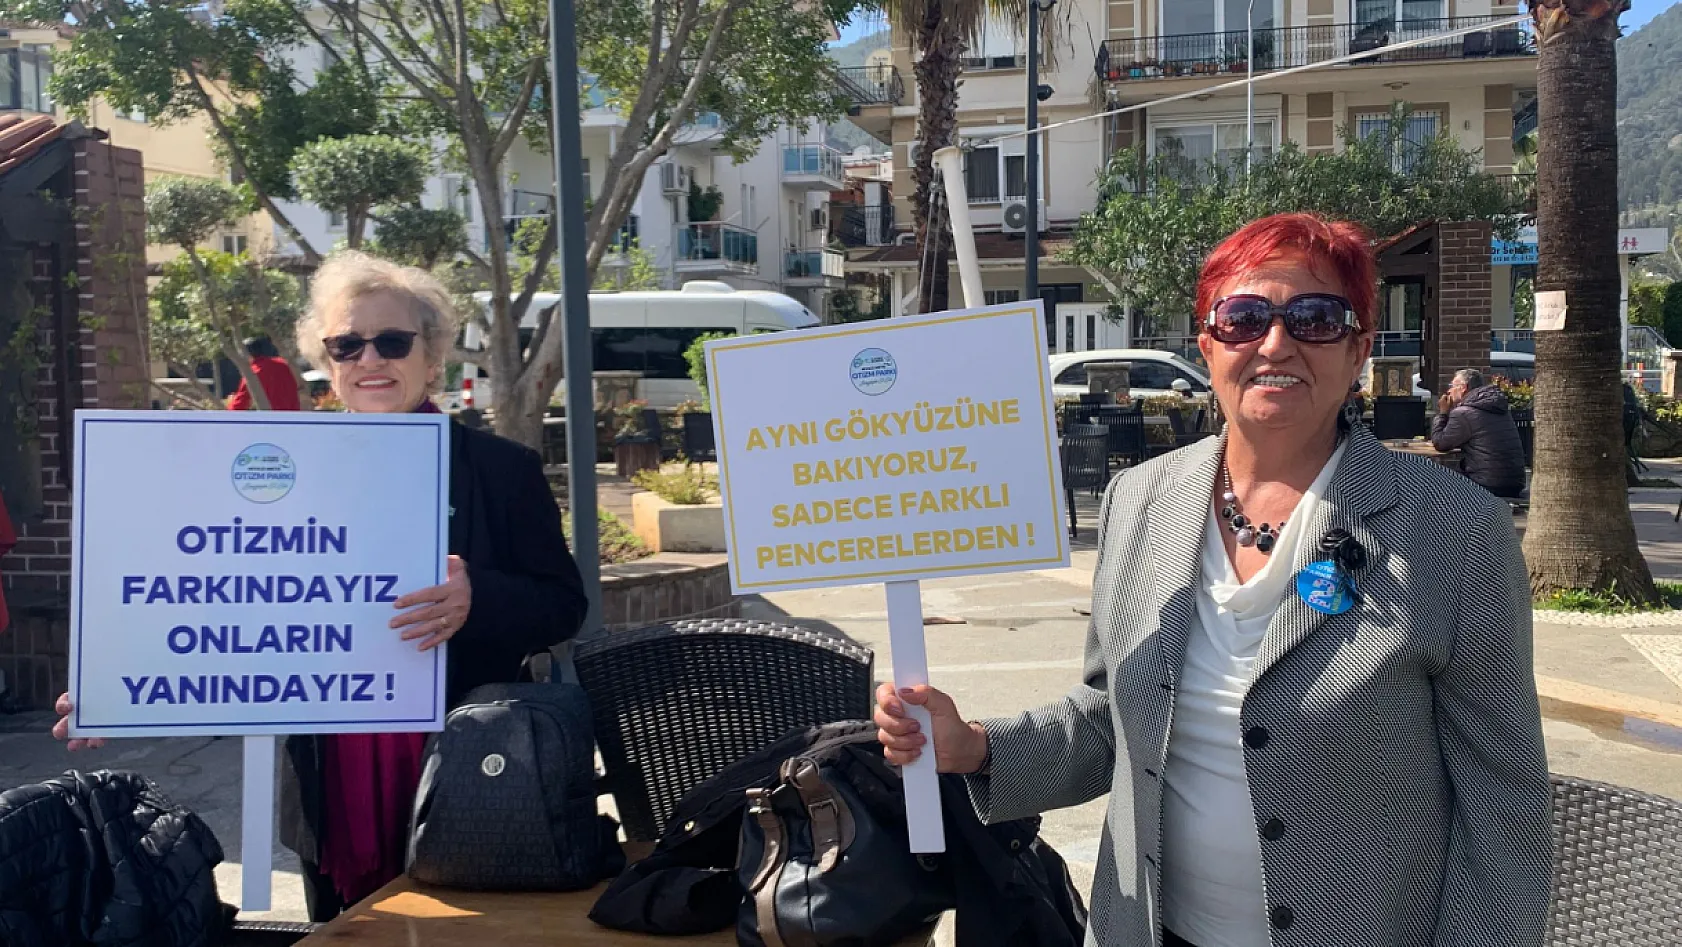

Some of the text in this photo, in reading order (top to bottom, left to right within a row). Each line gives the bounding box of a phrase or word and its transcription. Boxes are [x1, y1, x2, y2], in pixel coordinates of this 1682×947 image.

[747, 397, 1020, 450] AYNI GÖKYÜZÜNE
[792, 446, 977, 487] BAKIYORUZ,
[772, 484, 1009, 527] SADECE FARKLI
[177, 517, 346, 554] OTİZMİN
[756, 523, 1035, 569] PENCERELERDEN !
[122, 575, 399, 604] FARKINDAYIZ
[168, 625, 351, 654] ONLARIN
[122, 674, 394, 704] YANINDAYIZ !
